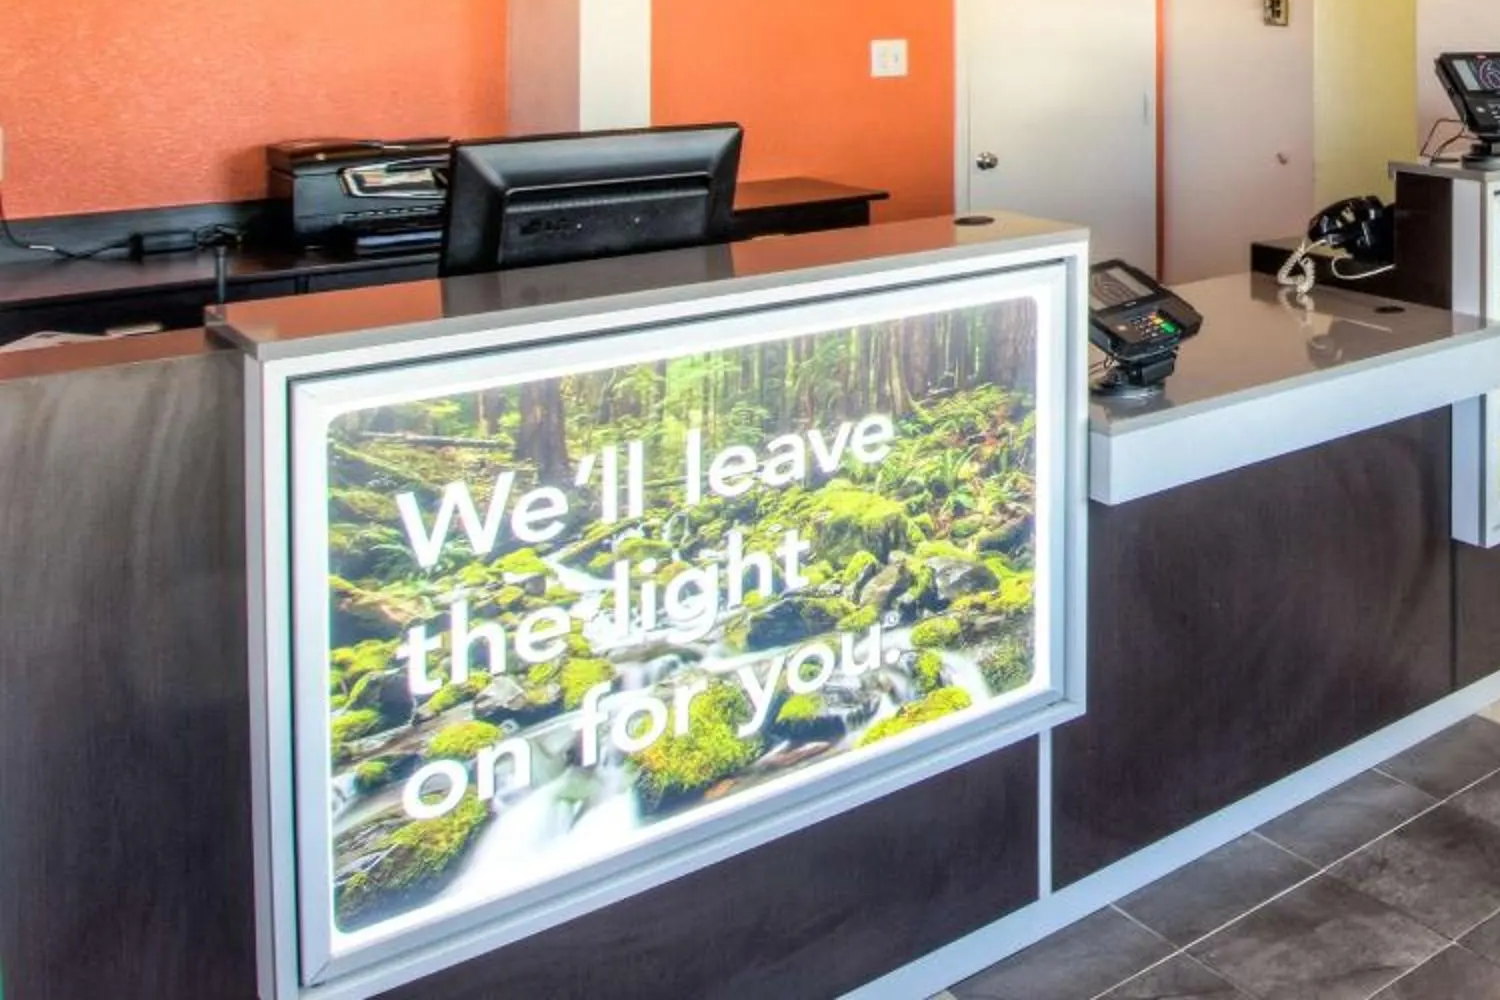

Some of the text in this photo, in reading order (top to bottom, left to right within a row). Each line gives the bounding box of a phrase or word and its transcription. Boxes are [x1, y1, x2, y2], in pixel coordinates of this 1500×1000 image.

[396, 414, 895, 569] We'll leave
[397, 529, 810, 695] the light
[402, 738, 531, 821] on
[573, 681, 706, 768] for
